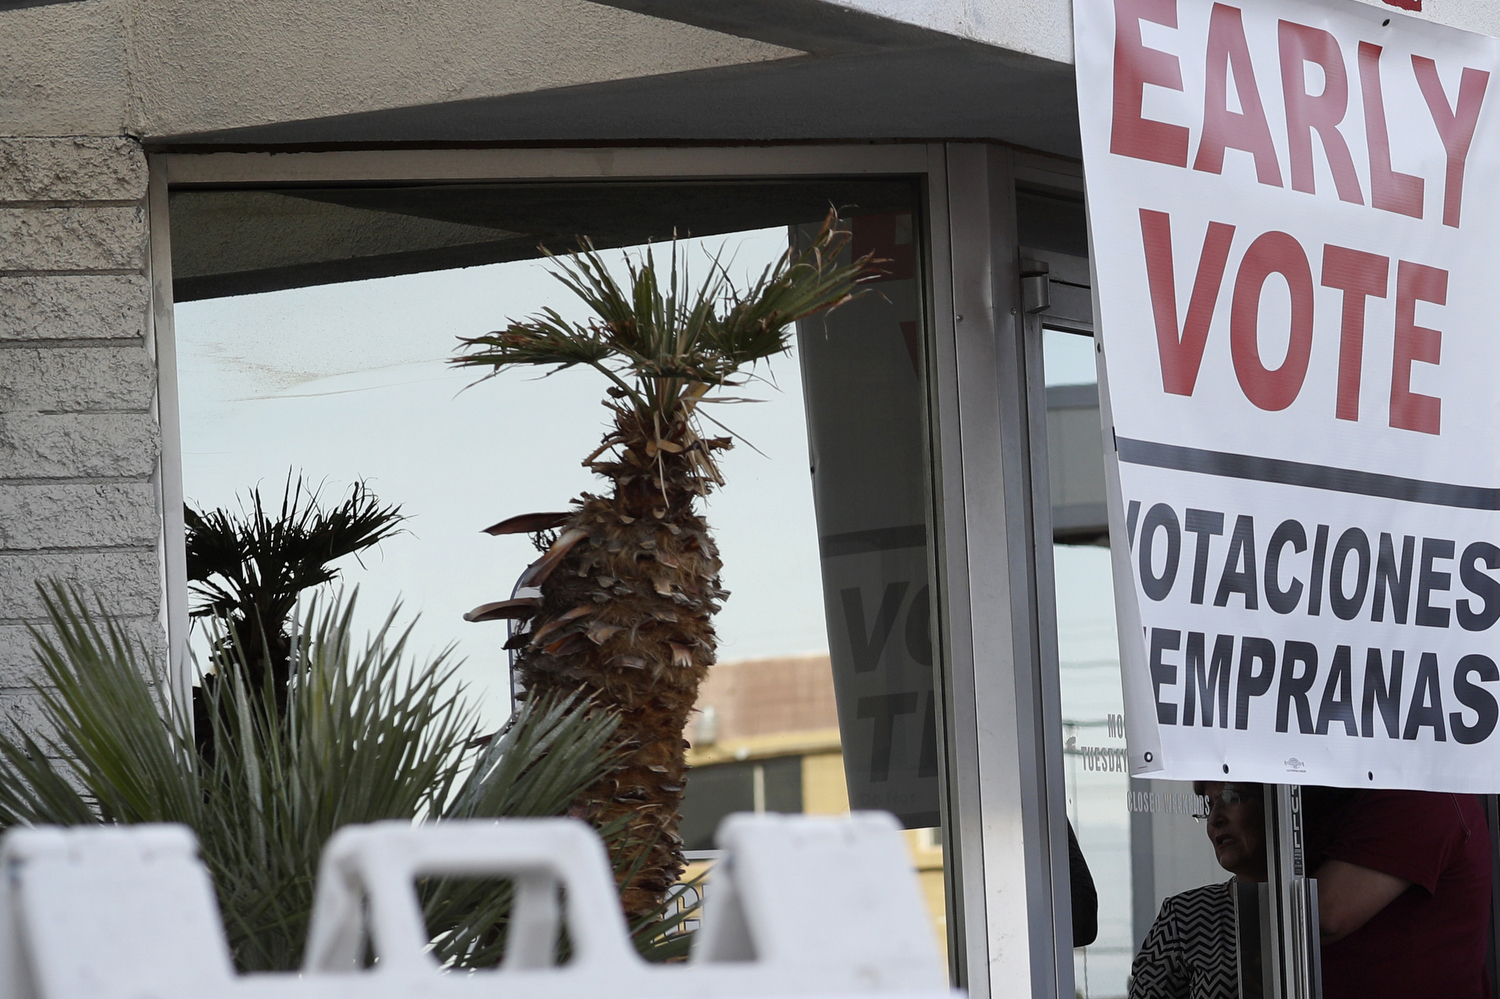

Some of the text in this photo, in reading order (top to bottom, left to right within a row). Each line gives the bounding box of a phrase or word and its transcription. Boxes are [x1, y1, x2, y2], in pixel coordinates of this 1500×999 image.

[1110, 0, 1491, 229] EARLY
[1140, 209, 1449, 436] VOTE
[1143, 627, 1500, 745] EMPRANAS
[1081, 746, 1128, 773] TUESDAY
[1126, 790, 1210, 816] CLOSED WEEKENDS
[1290, 784, 1301, 849] PULL
